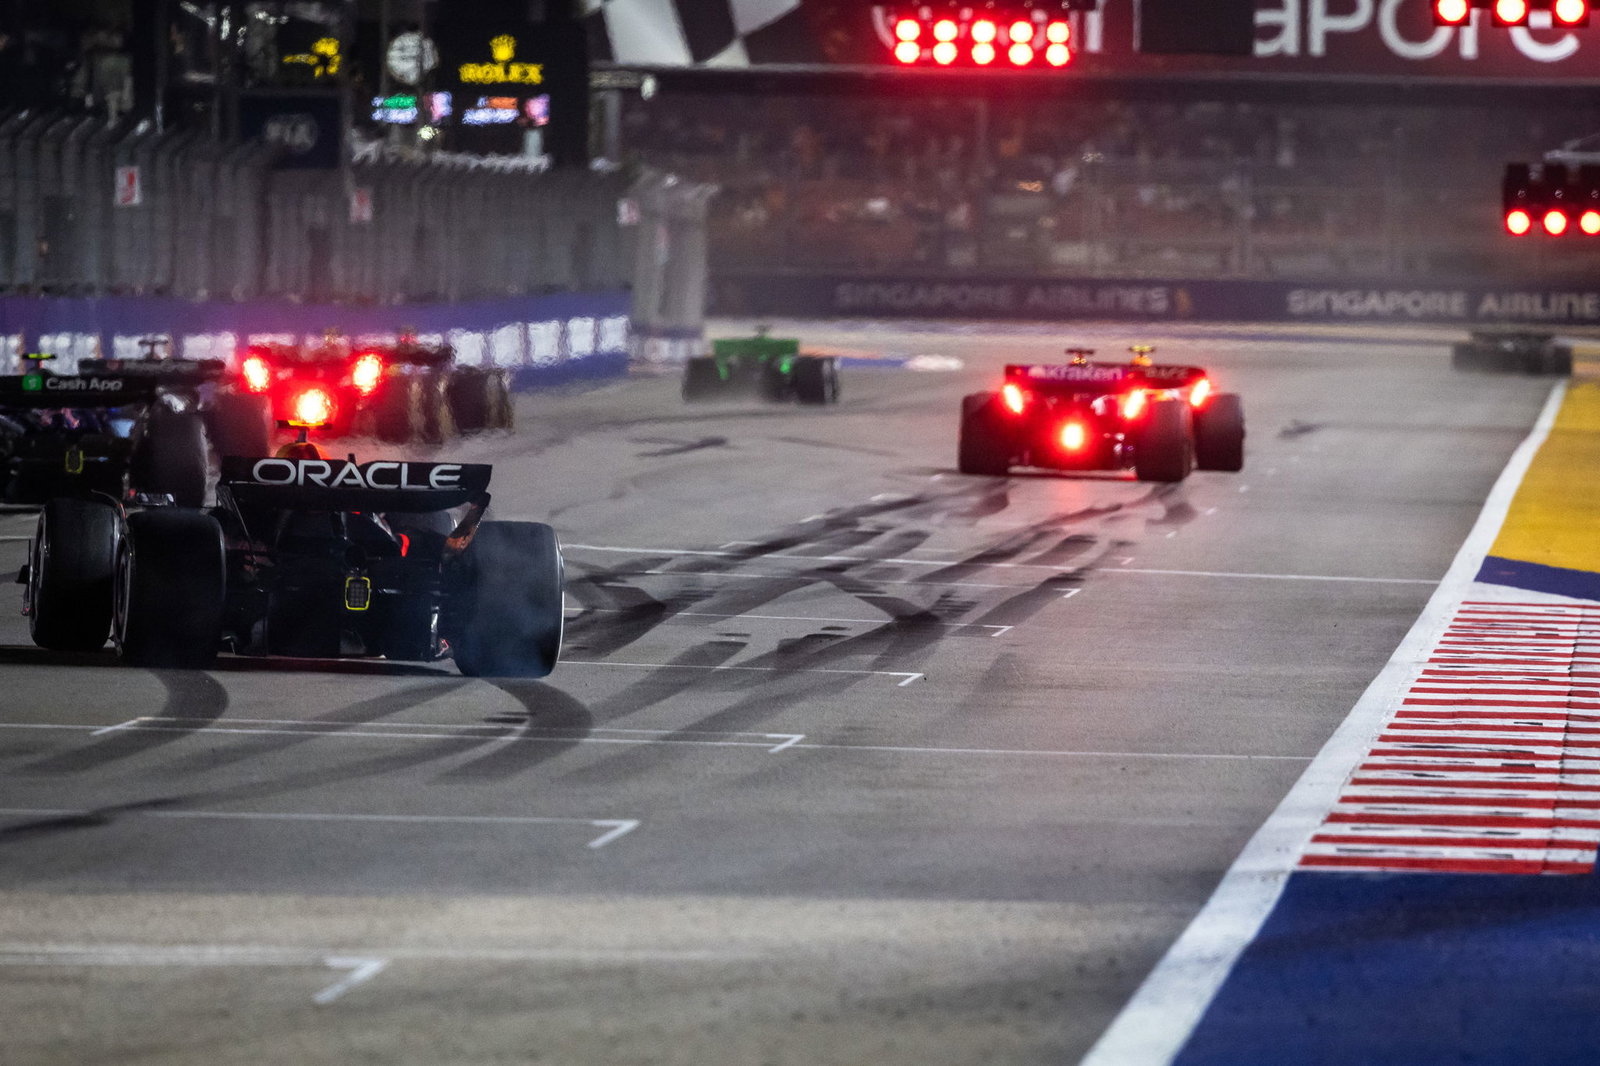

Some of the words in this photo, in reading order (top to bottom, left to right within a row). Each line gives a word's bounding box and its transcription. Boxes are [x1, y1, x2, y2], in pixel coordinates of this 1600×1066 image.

[1287, 289, 1466, 315] SINGAPORE
[46, 379, 86, 390] Cash
[89, 379, 123, 391] App
[252, 458, 462, 489] ORACLE
